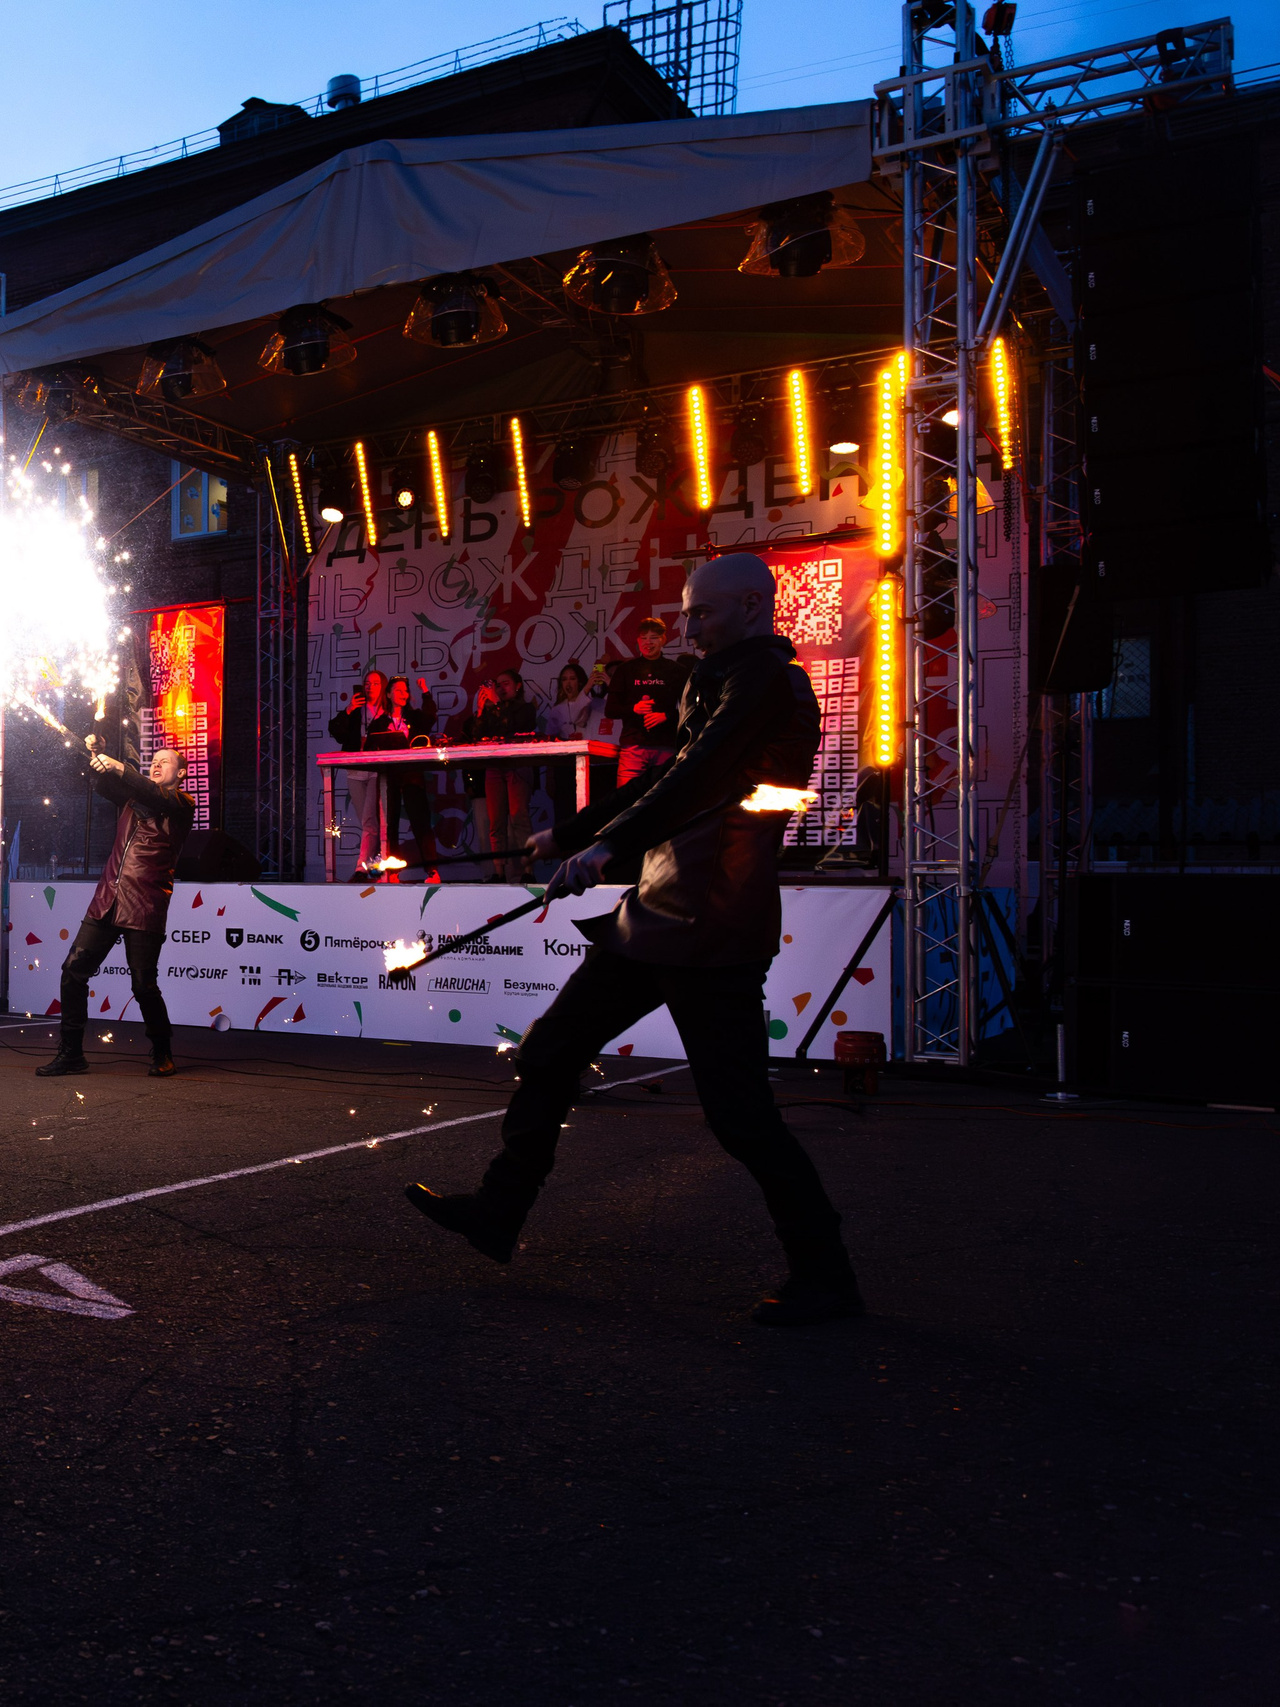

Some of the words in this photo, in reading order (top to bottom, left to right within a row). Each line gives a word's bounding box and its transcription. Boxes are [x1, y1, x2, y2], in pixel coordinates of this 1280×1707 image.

[326, 497, 499, 567] ДЕНЬ
[171, 930, 211, 944] СБЕР
[247, 934, 284, 944] BANK
[438, 934, 490, 945] НАУНОЕ
[543, 938, 595, 957] Конт
[103, 966, 132, 976] АВТОС
[434, 977, 486, 992] HARUCHA
[504, 979, 559, 992] Безумно.
